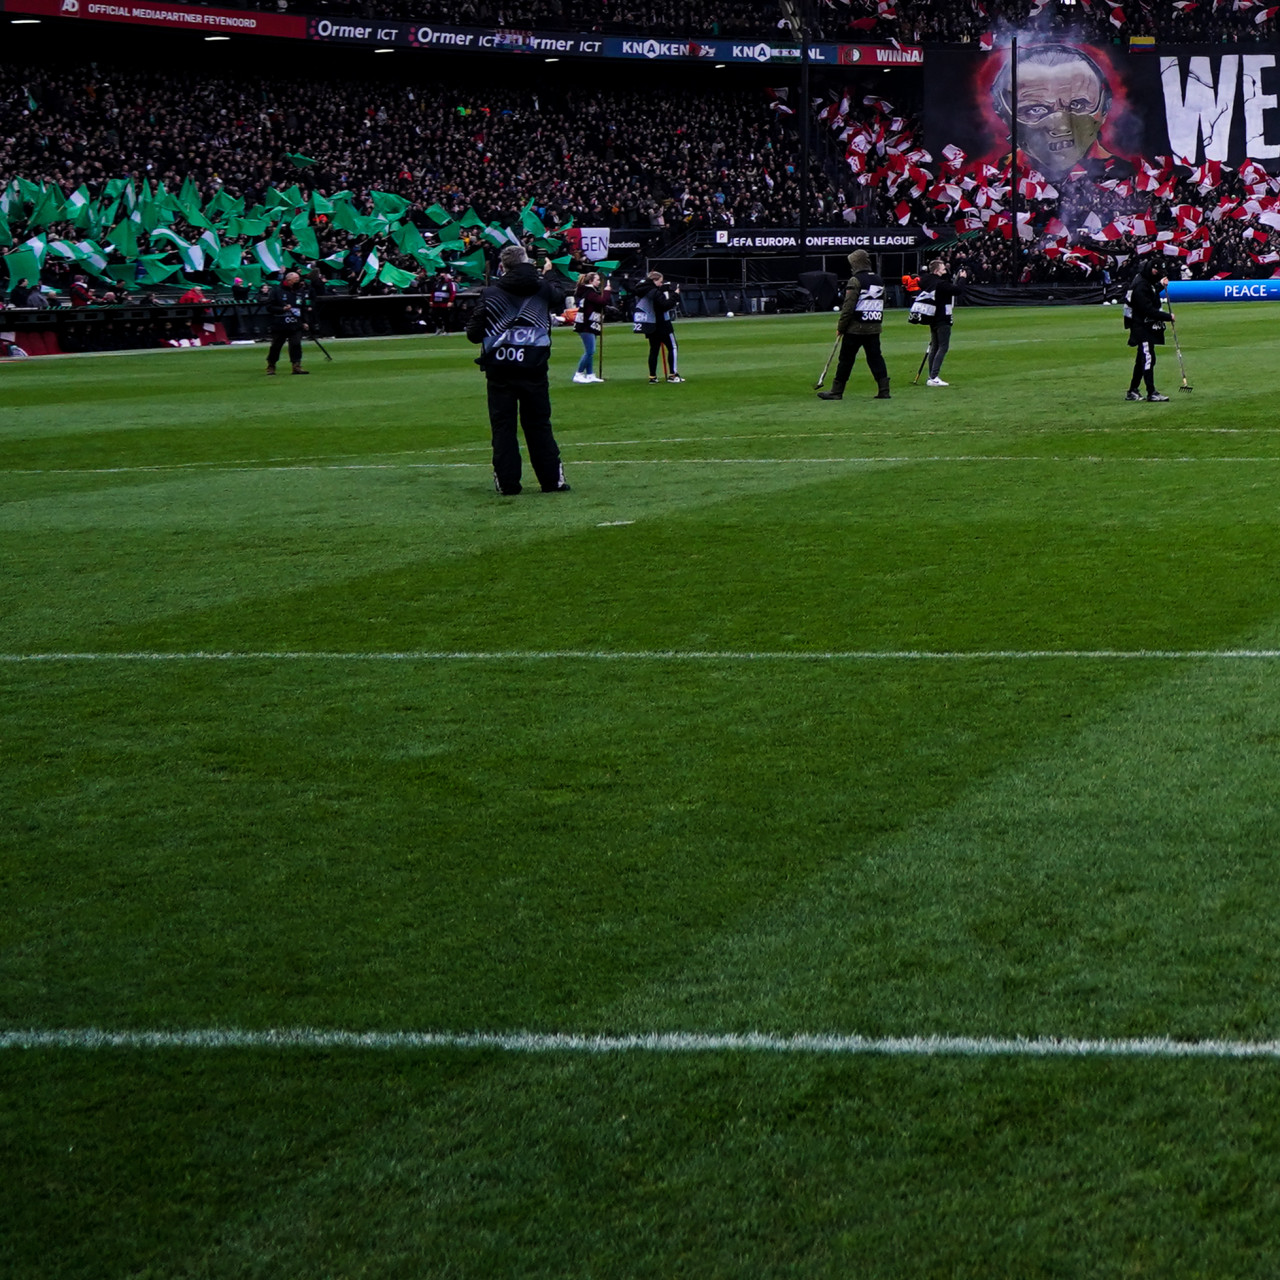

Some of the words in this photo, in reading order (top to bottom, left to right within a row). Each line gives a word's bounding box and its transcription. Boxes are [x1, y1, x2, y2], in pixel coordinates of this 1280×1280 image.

[88, 4, 131, 18] OFFICIAL
[132, 8, 202, 24] MEDIAPARTNER
[204, 15, 256, 28] FEYENOORD
[318, 20, 372, 38] Ormer
[377, 27, 398, 41] ICT
[417, 27, 473, 46] Ormer
[534, 37, 574, 51] rmer
[579, 41, 602, 53] ICT
[755, 236, 796, 247] EUROPA
[799, 235, 870, 246] ONFERENCE
[873, 235, 917, 246] LEAGUE
[1224, 285, 1267, 298] PEACE
[495, 347, 525, 362] 006
